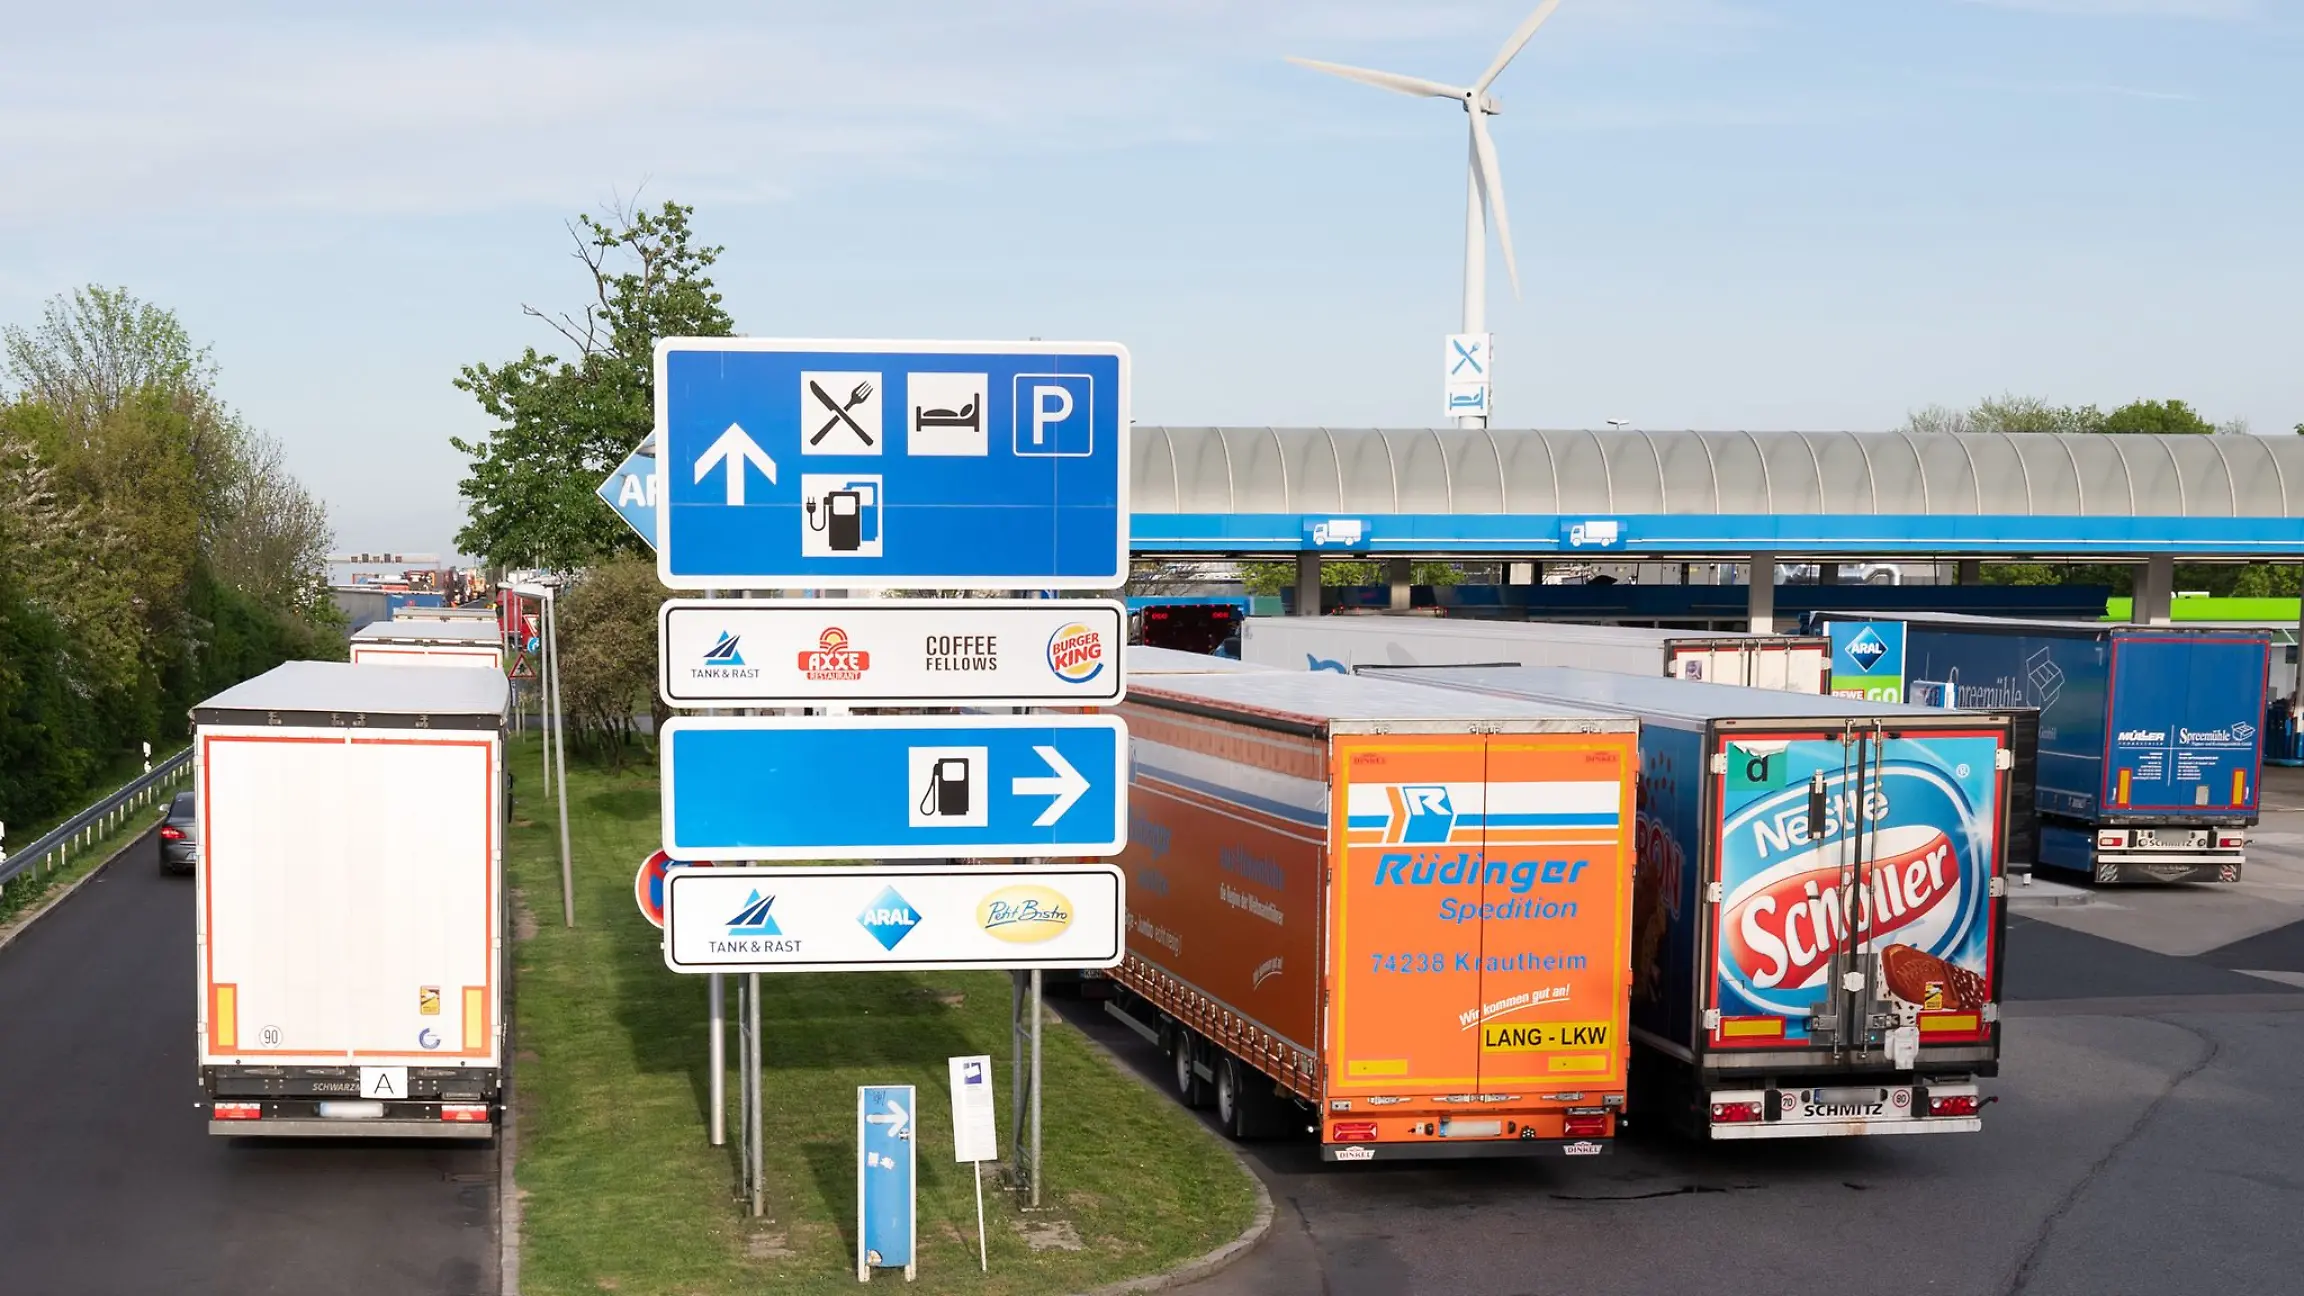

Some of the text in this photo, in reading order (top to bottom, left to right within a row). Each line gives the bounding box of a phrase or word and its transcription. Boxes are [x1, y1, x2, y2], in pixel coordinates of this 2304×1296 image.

[1033, 385, 1073, 444] P
[926, 635, 997, 656] COFFEE
[1052, 632, 1099, 655] BURGER
[1851, 642, 1882, 655] ARAL
[808, 652, 860, 671] AXXE
[926, 657, 997, 671] FELLOWS
[1054, 643, 1101, 671] KING
[691, 668, 760, 678] TANK & RAST
[1867, 687, 1898, 703] GO
[2179, 728, 2231, 744] Spreemühle
[1374, 853, 1590, 894] Rüdinger
[863, 908, 915, 926] ARAL
[989, 901, 1019, 924] Petit
[1438, 896, 1579, 925] Spedition
[709, 940, 802, 953] TANK & RAST
[1371, 951, 1587, 974] 74238 Krautheim
[1459, 983, 1571, 1026] Wir kommen gut an!
[264, 1029, 279, 1044] 90
[1486, 1028, 1542, 1047] LANG
[1561, 1027, 1607, 1045] LKW
[373, 1073, 394, 1094] A
[1782, 1097, 1793, 1107] 70
[1804, 1103, 1883, 1117] SCHMITZ
